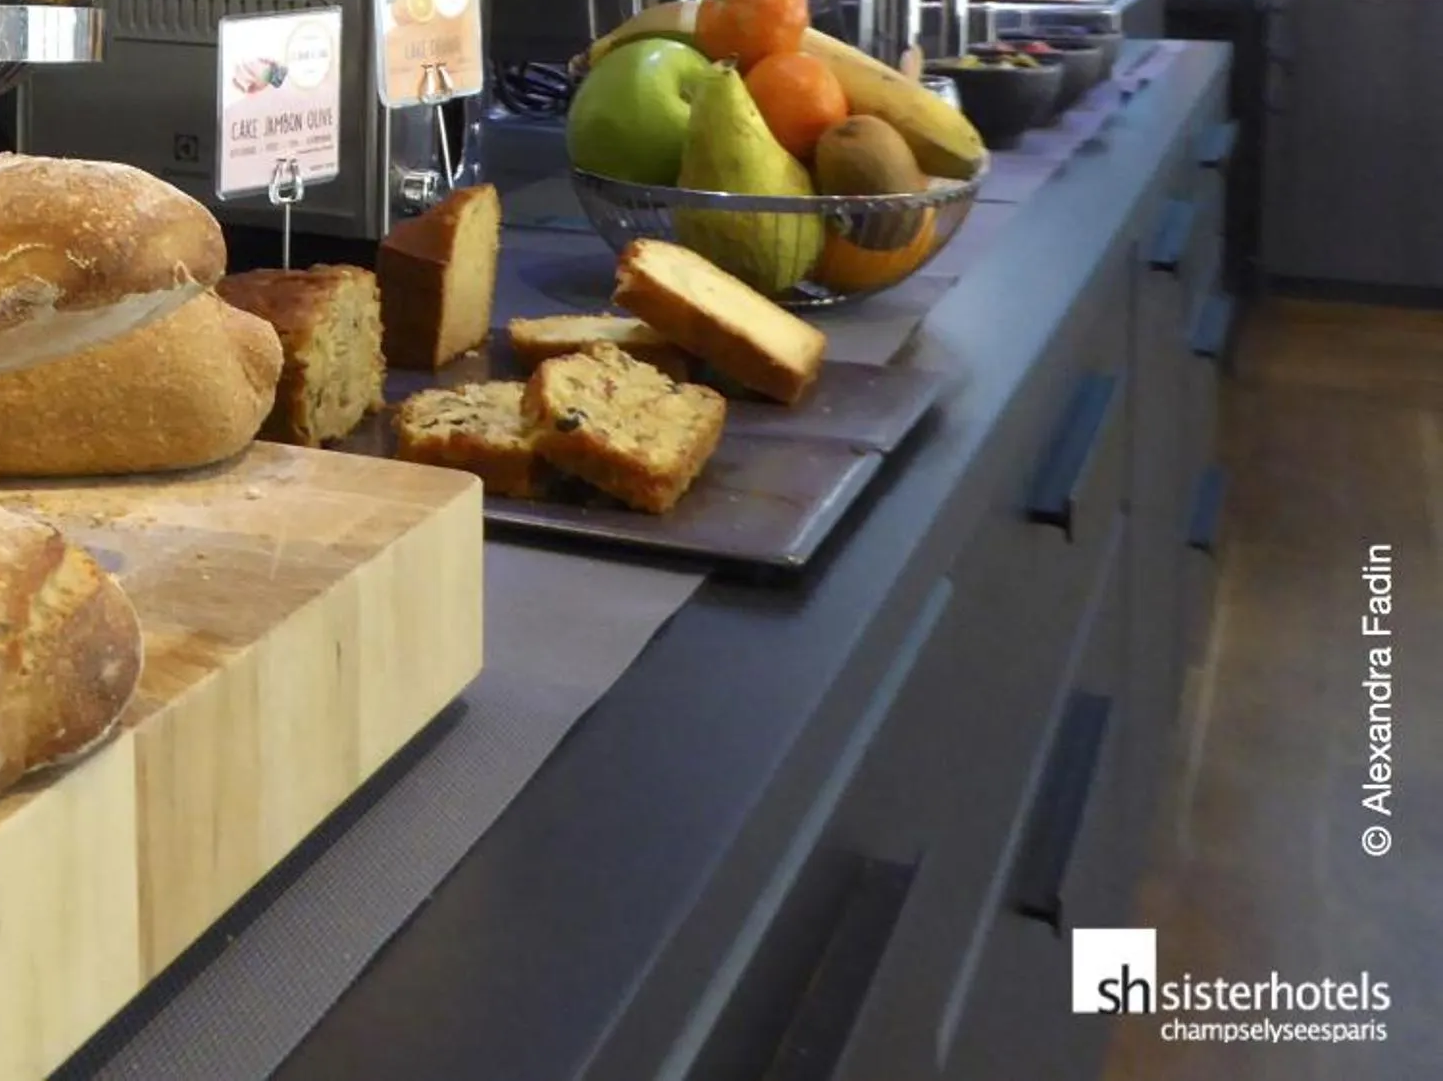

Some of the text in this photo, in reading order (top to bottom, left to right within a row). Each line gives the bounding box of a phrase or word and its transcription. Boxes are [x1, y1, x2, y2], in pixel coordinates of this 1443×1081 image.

[231, 107, 333, 141] CAKE JAMBON OLIVE
